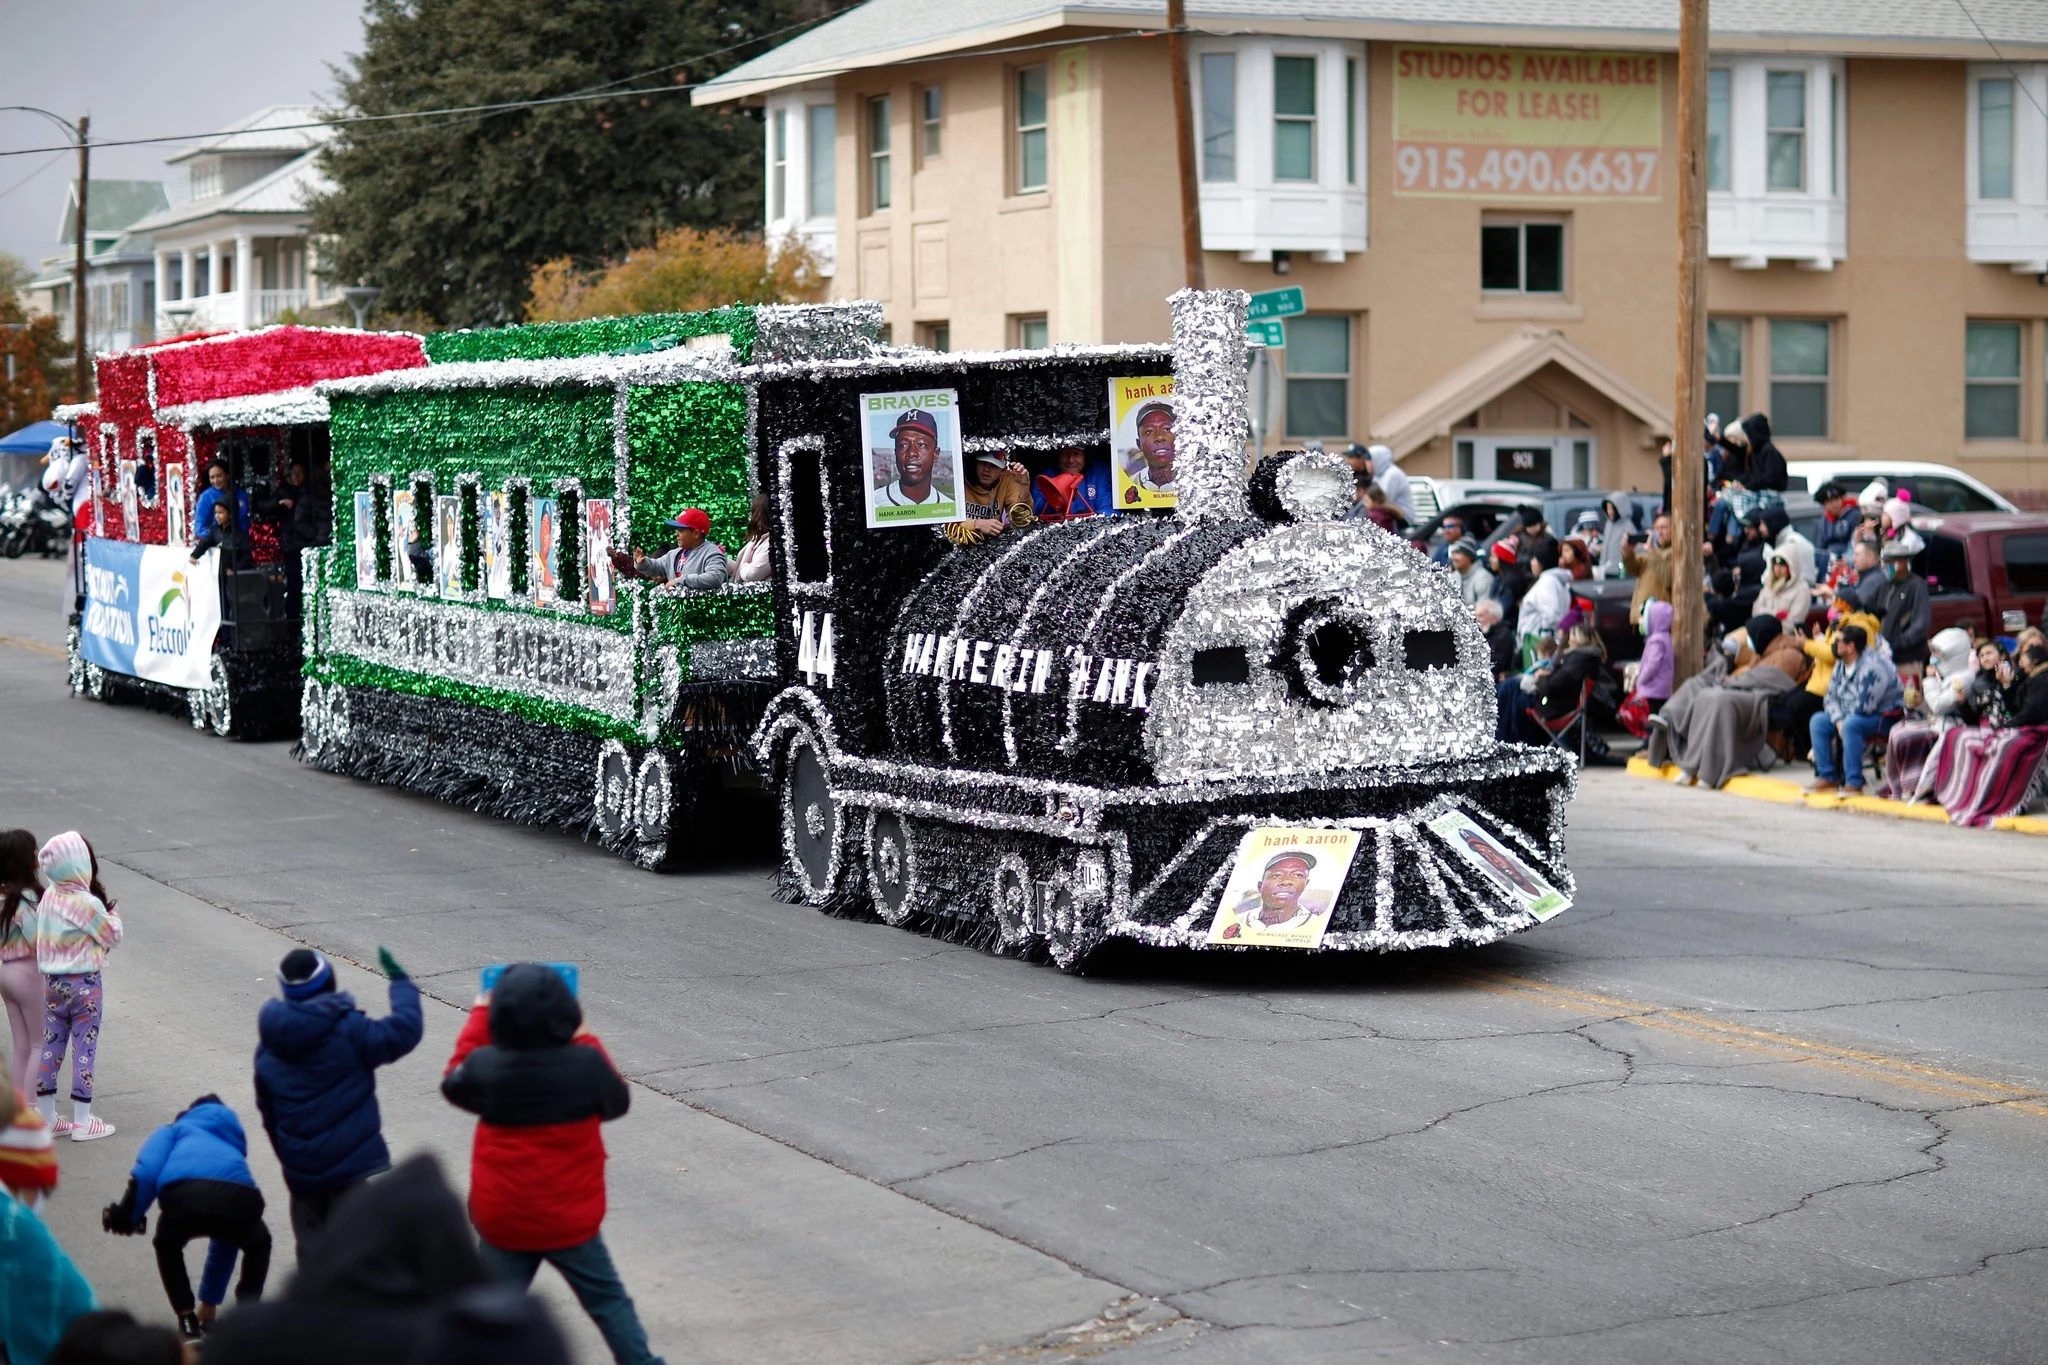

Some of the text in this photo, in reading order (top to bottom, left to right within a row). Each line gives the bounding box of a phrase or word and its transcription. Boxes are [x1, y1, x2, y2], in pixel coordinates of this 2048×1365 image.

[1399, 50, 1657, 86] STUDIOS AVAILABLE
[1456, 89, 1600, 121] FOR LEASE!
[1398, 146, 1658, 193] 915.490.6637
[868, 393, 950, 411] BRAVES
[1125, 384, 1155, 400] hank
[906, 410, 919, 422] M
[897, 509, 916, 517] AARON
[798, 610, 836, 689] 44
[1432, 813, 1470, 835] BRAVES
[1263, 834, 1348, 847] hank aaron
